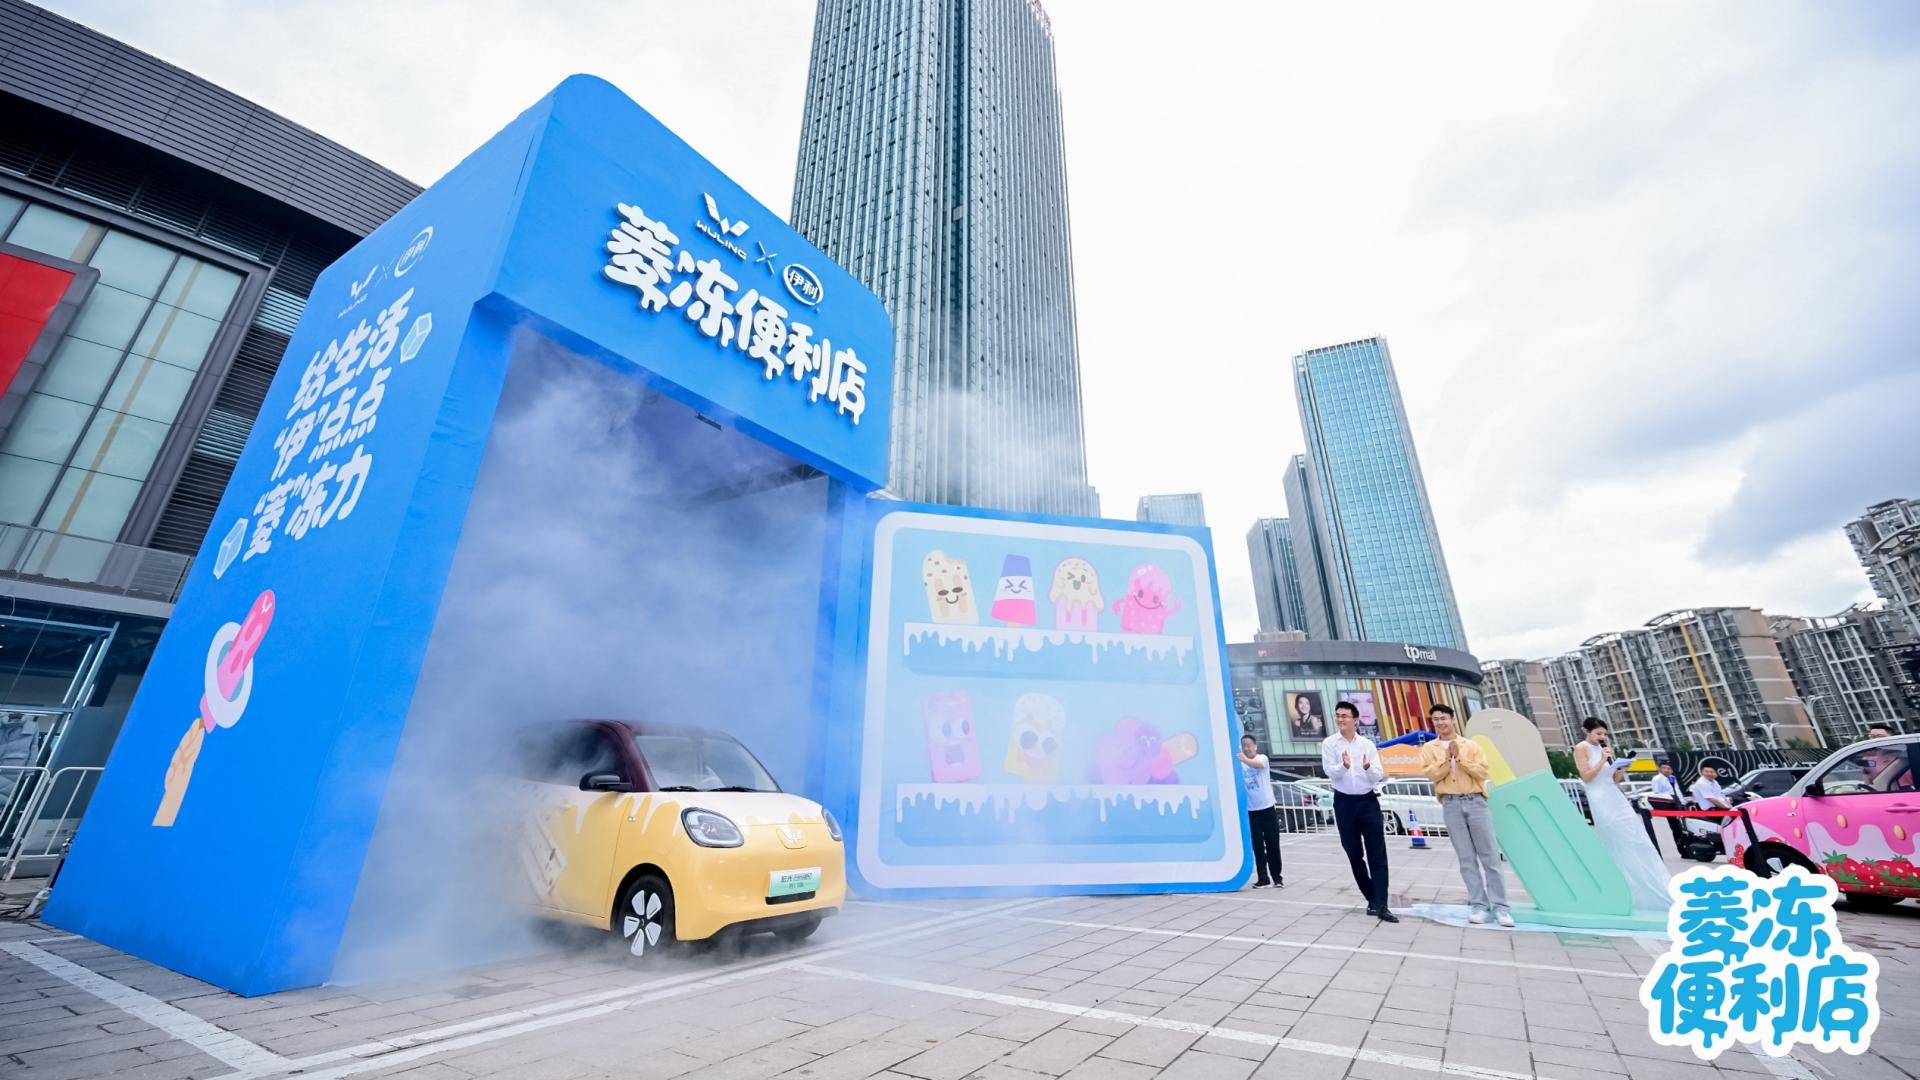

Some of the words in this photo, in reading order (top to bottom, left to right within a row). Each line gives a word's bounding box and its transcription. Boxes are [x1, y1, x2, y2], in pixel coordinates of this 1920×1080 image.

[696, 219, 748, 261] WULING
[602, 202, 868, 426] 菱冻便利店
[788, 270, 819, 300] 伊利
[286, 287, 415, 420] 给生活
